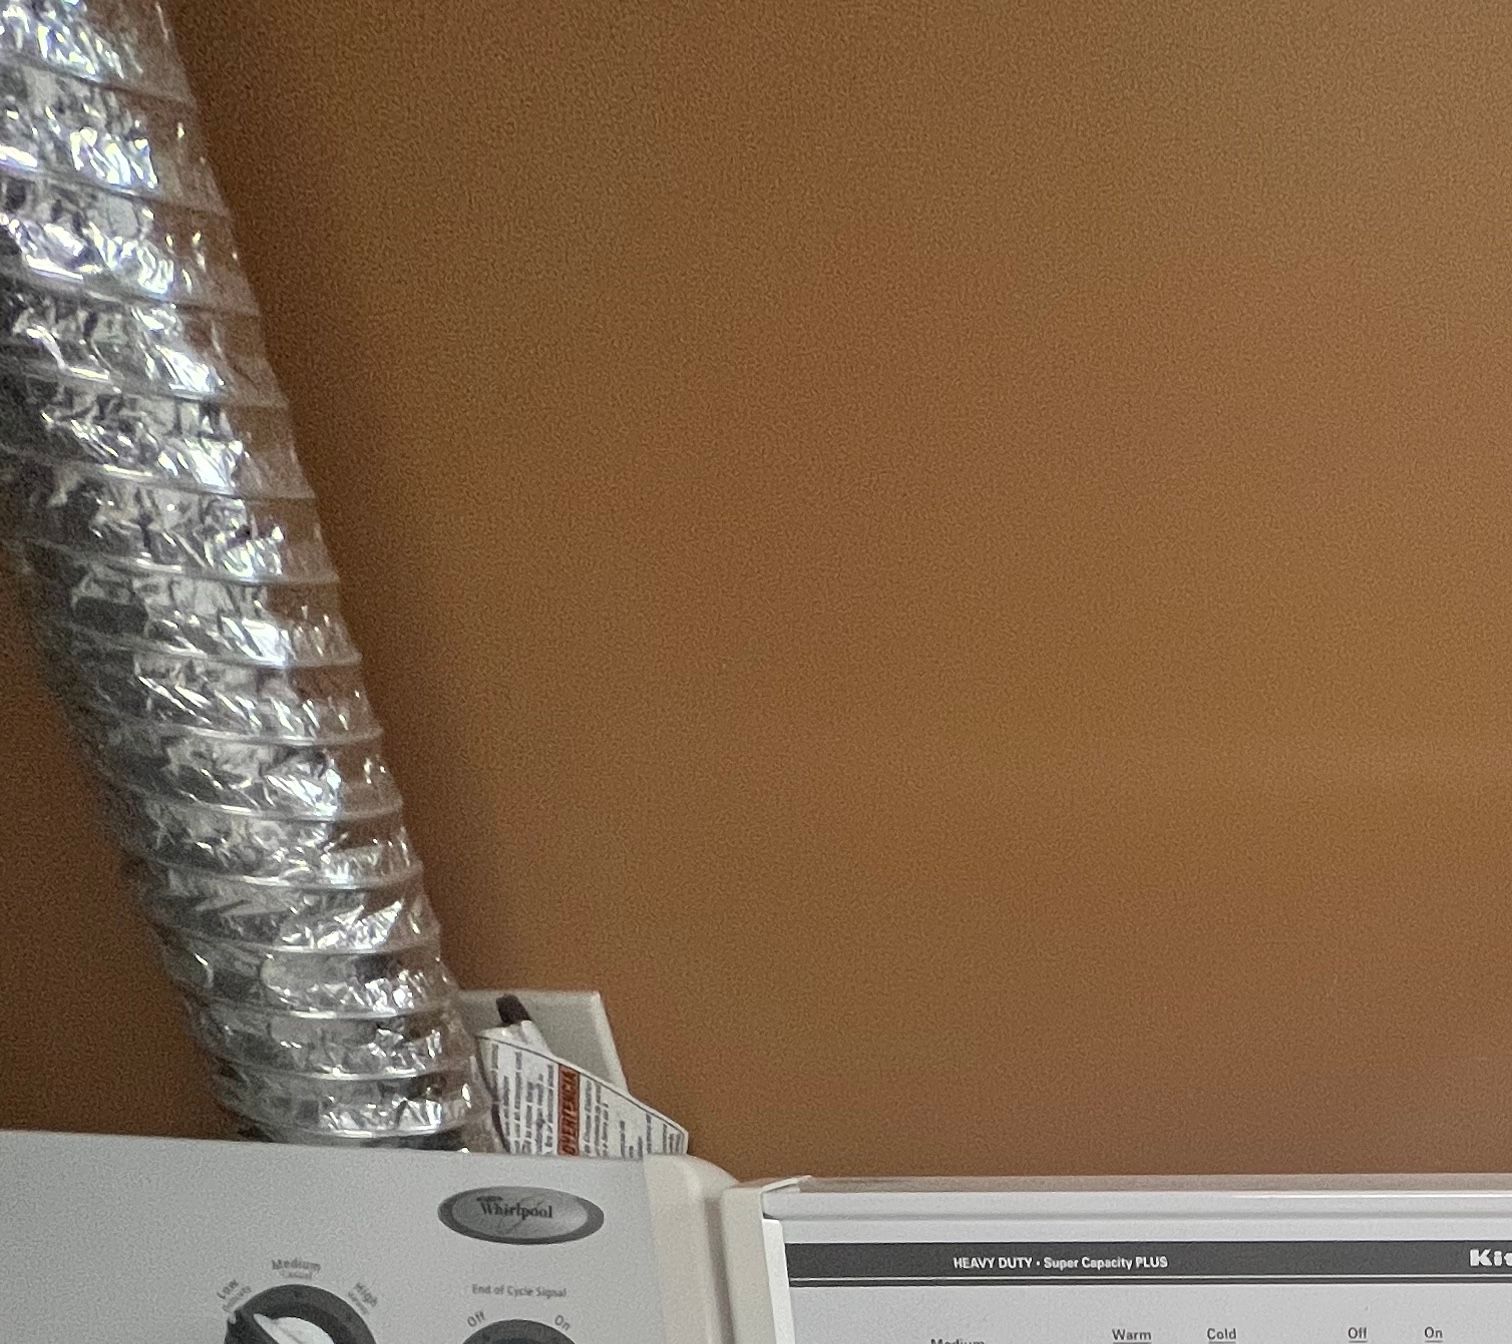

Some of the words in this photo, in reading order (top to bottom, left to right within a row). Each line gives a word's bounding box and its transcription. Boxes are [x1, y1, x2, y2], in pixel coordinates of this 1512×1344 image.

[478, 1200, 553, 1221] Whirlpool
[271, 1258, 322, 1273] Medium
[953, 1257, 995, 1269] HEAVY
[999, 1257, 1033, 1269] DUTY
[1043, 1257, 1079, 1271] Super
[1081, 1256, 1133, 1270] Capacity
[1135, 1256, 1168, 1268] PLUS
[472, 1284, 492, 1295] End
[494, 1285, 505, 1295] of
[507, 1286, 534, 1298] Cycle
[535, 1286, 568, 1300] Signal
[466, 1310, 486, 1328] Off
[554, 1314, 572, 1332] On
[1112, 1328, 1152, 1341] Warm
[1206, 1327, 1237, 1341] Cold
[1348, 1327, 1368, 1340] Off
[1424, 1326, 1443, 1339] On
